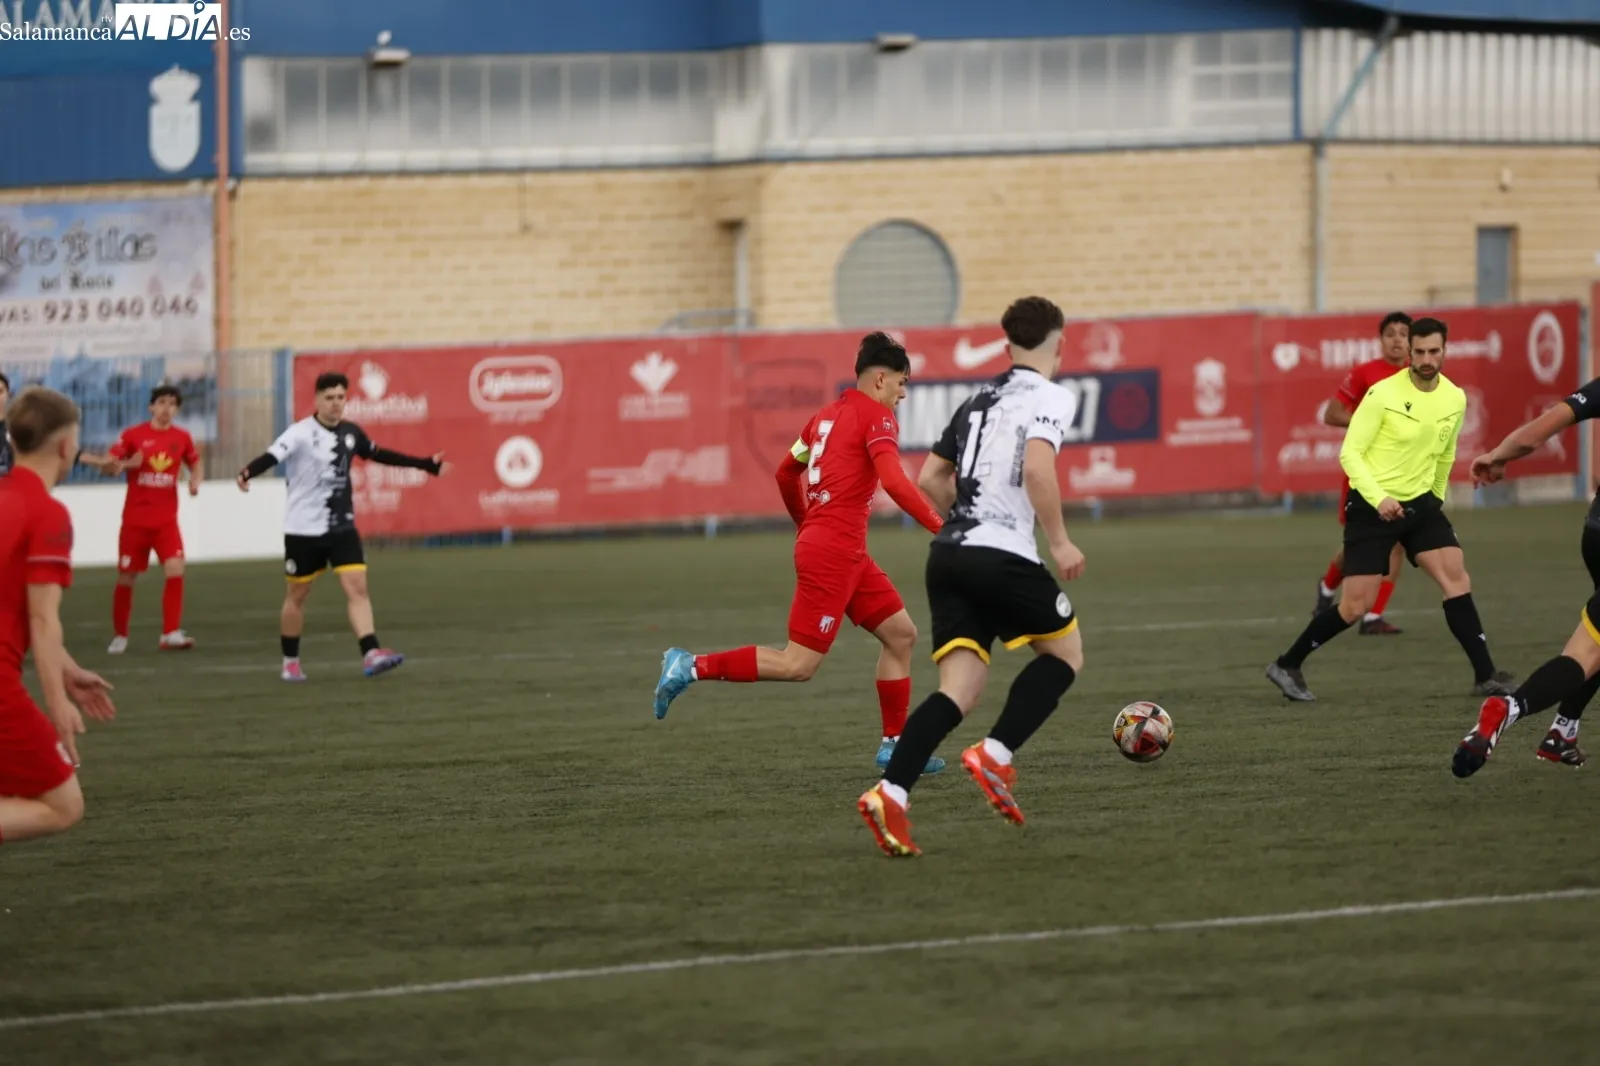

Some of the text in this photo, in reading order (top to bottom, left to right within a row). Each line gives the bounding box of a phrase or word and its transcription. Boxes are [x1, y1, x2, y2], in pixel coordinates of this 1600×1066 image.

[43, 299, 88, 323] 923
[98, 298, 145, 321] 040
[807, 420, 834, 485] 2
